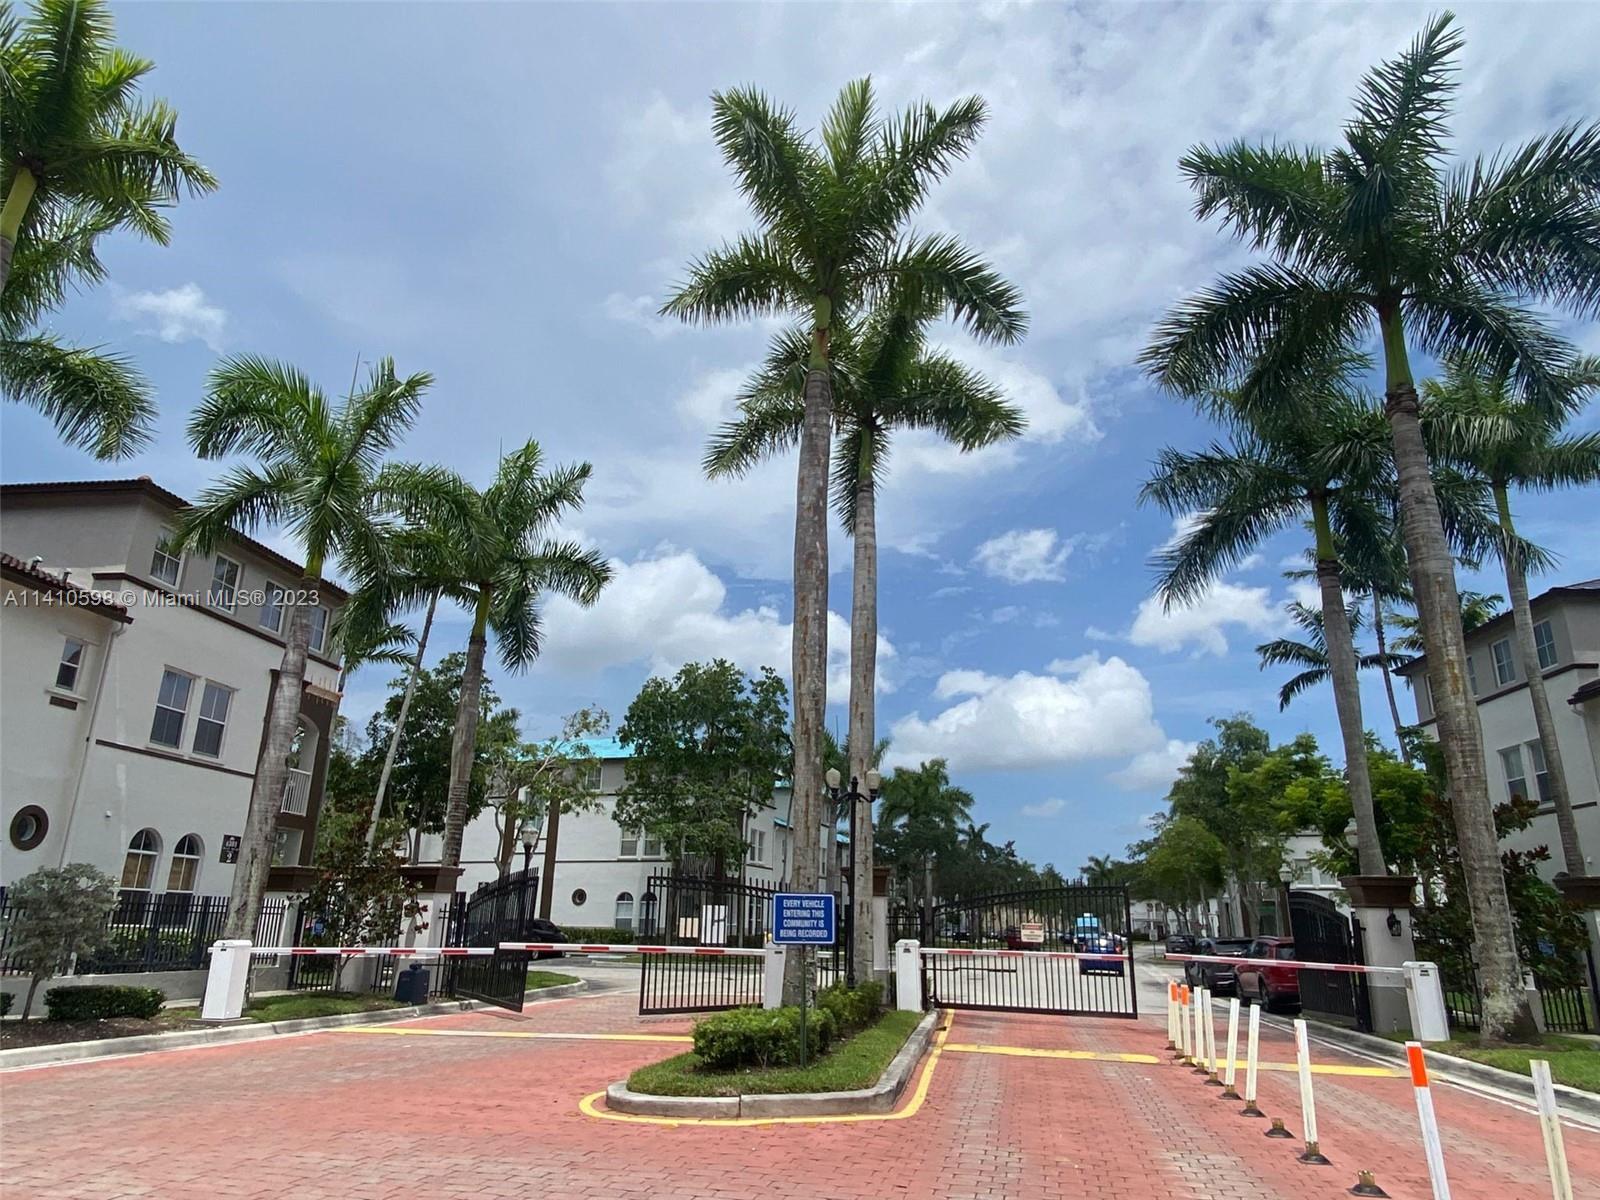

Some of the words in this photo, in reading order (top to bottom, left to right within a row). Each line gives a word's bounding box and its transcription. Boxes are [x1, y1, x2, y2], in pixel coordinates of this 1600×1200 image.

[783, 899, 801, 908] EVERY
[801, 899, 825, 908] VEHICLE
[783, 909, 811, 918] ENTERING
[811, 909, 825, 918] THIS
[783, 919, 818, 928] COMMUNITY
[818, 919, 825, 928] IS
[780, 929, 797, 938] BEING
[797, 929, 828, 938] RECORDED
